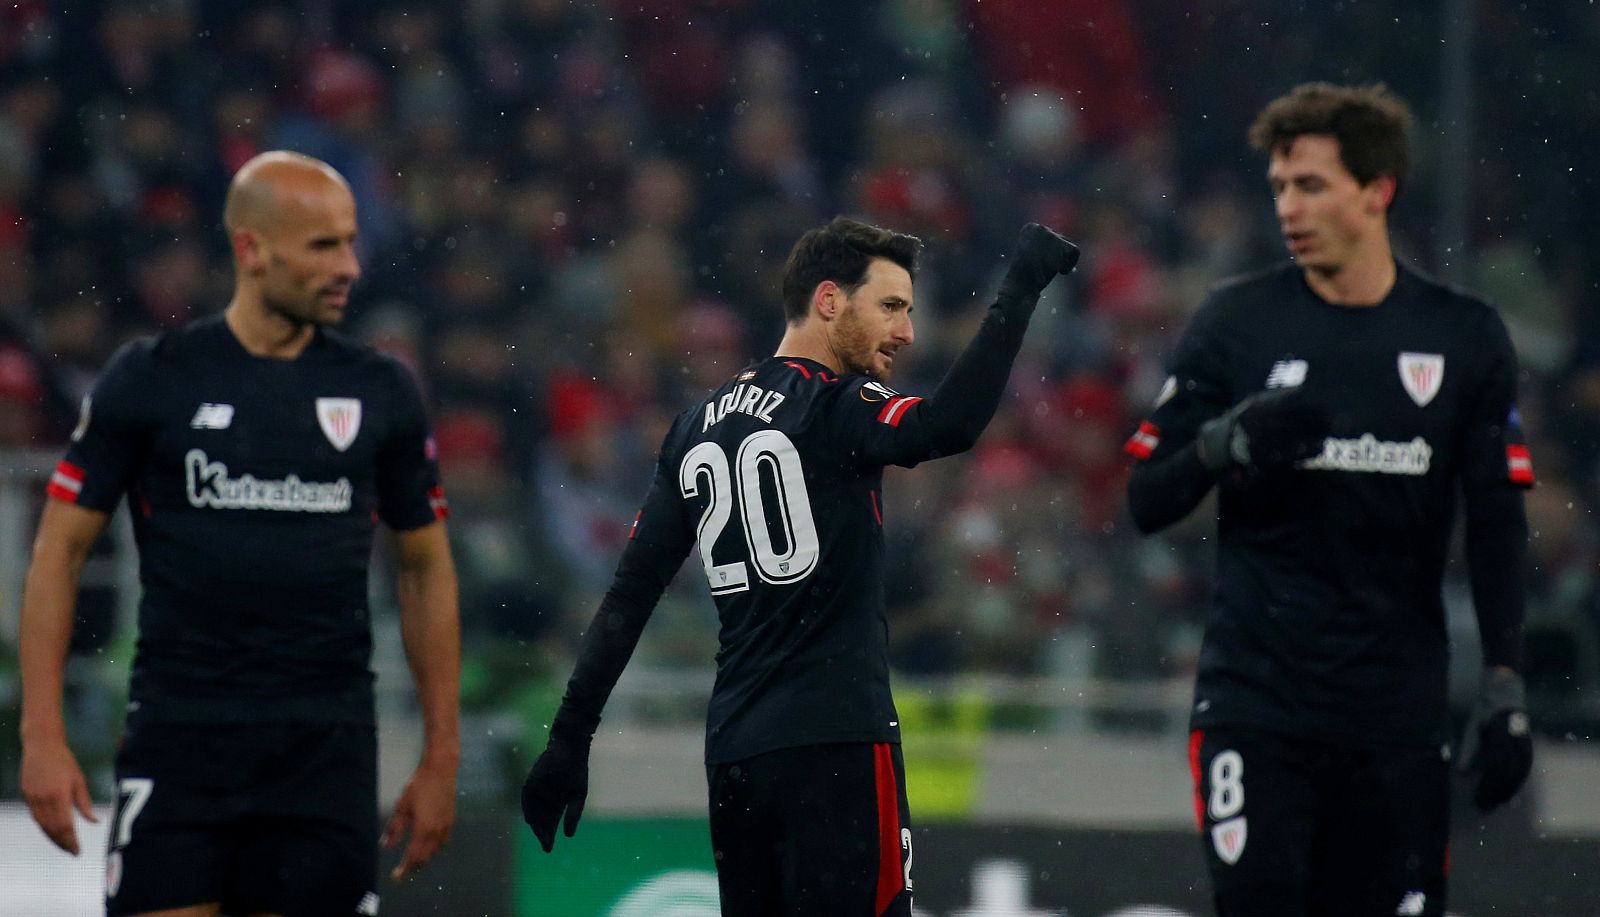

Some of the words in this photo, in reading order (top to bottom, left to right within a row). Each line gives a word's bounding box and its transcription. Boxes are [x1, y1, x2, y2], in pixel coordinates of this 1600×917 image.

[702, 383, 786, 433] ADURIZ
[185, 448, 353, 514] Kutxabank
[679, 429, 820, 597] 20
[1207, 749, 1245, 821] 8
